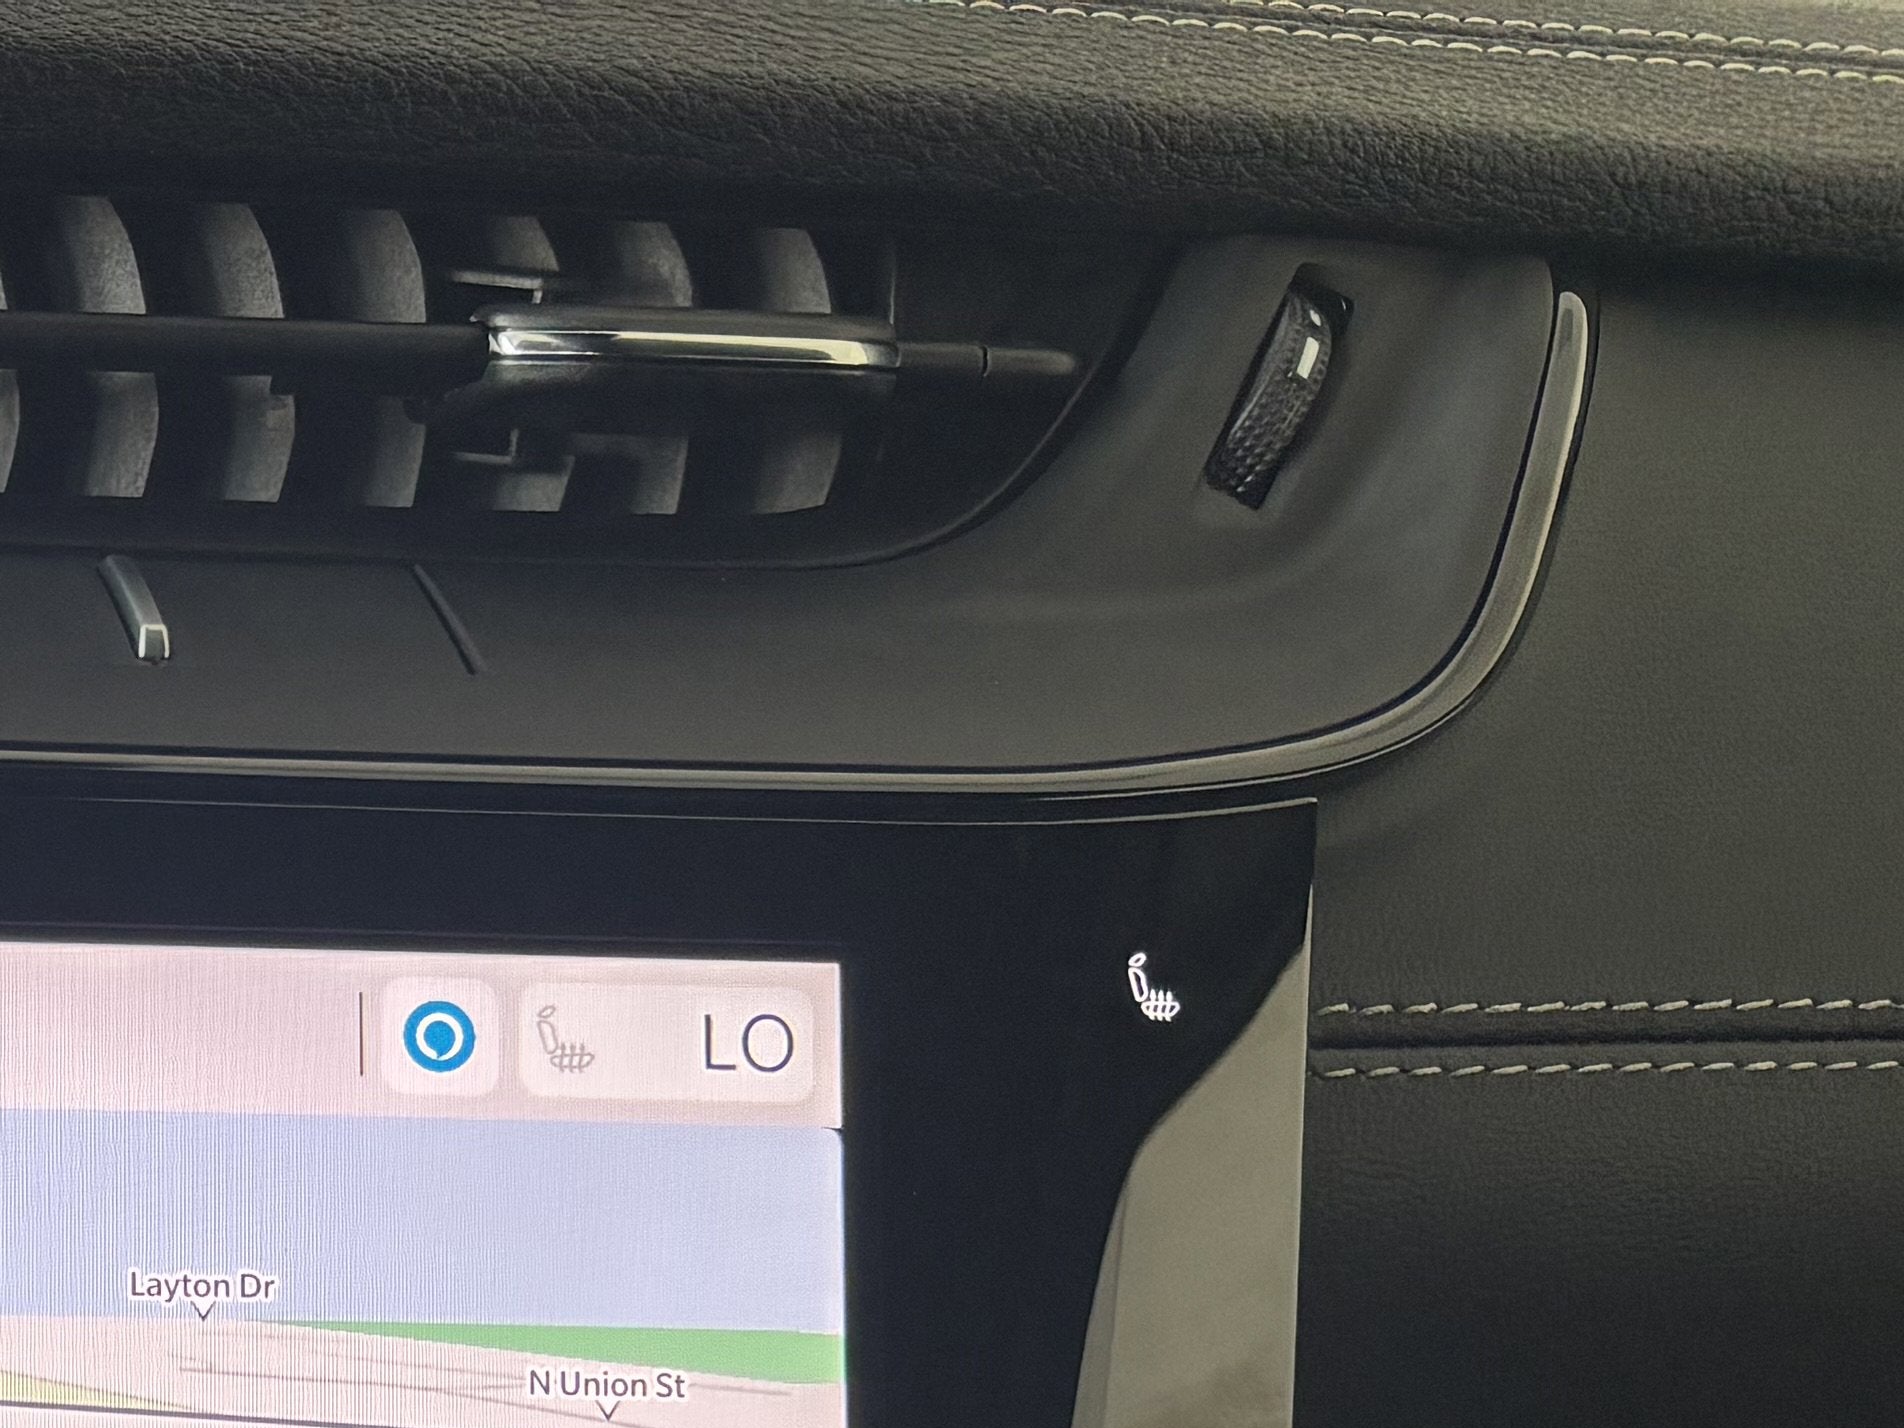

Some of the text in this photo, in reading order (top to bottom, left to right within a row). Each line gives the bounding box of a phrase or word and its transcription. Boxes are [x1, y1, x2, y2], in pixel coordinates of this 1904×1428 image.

[702, 1012, 795, 1075] LO
[131, 1271, 275, 1302] Layton Dr
[530, 1370, 686, 1398] N Union St
